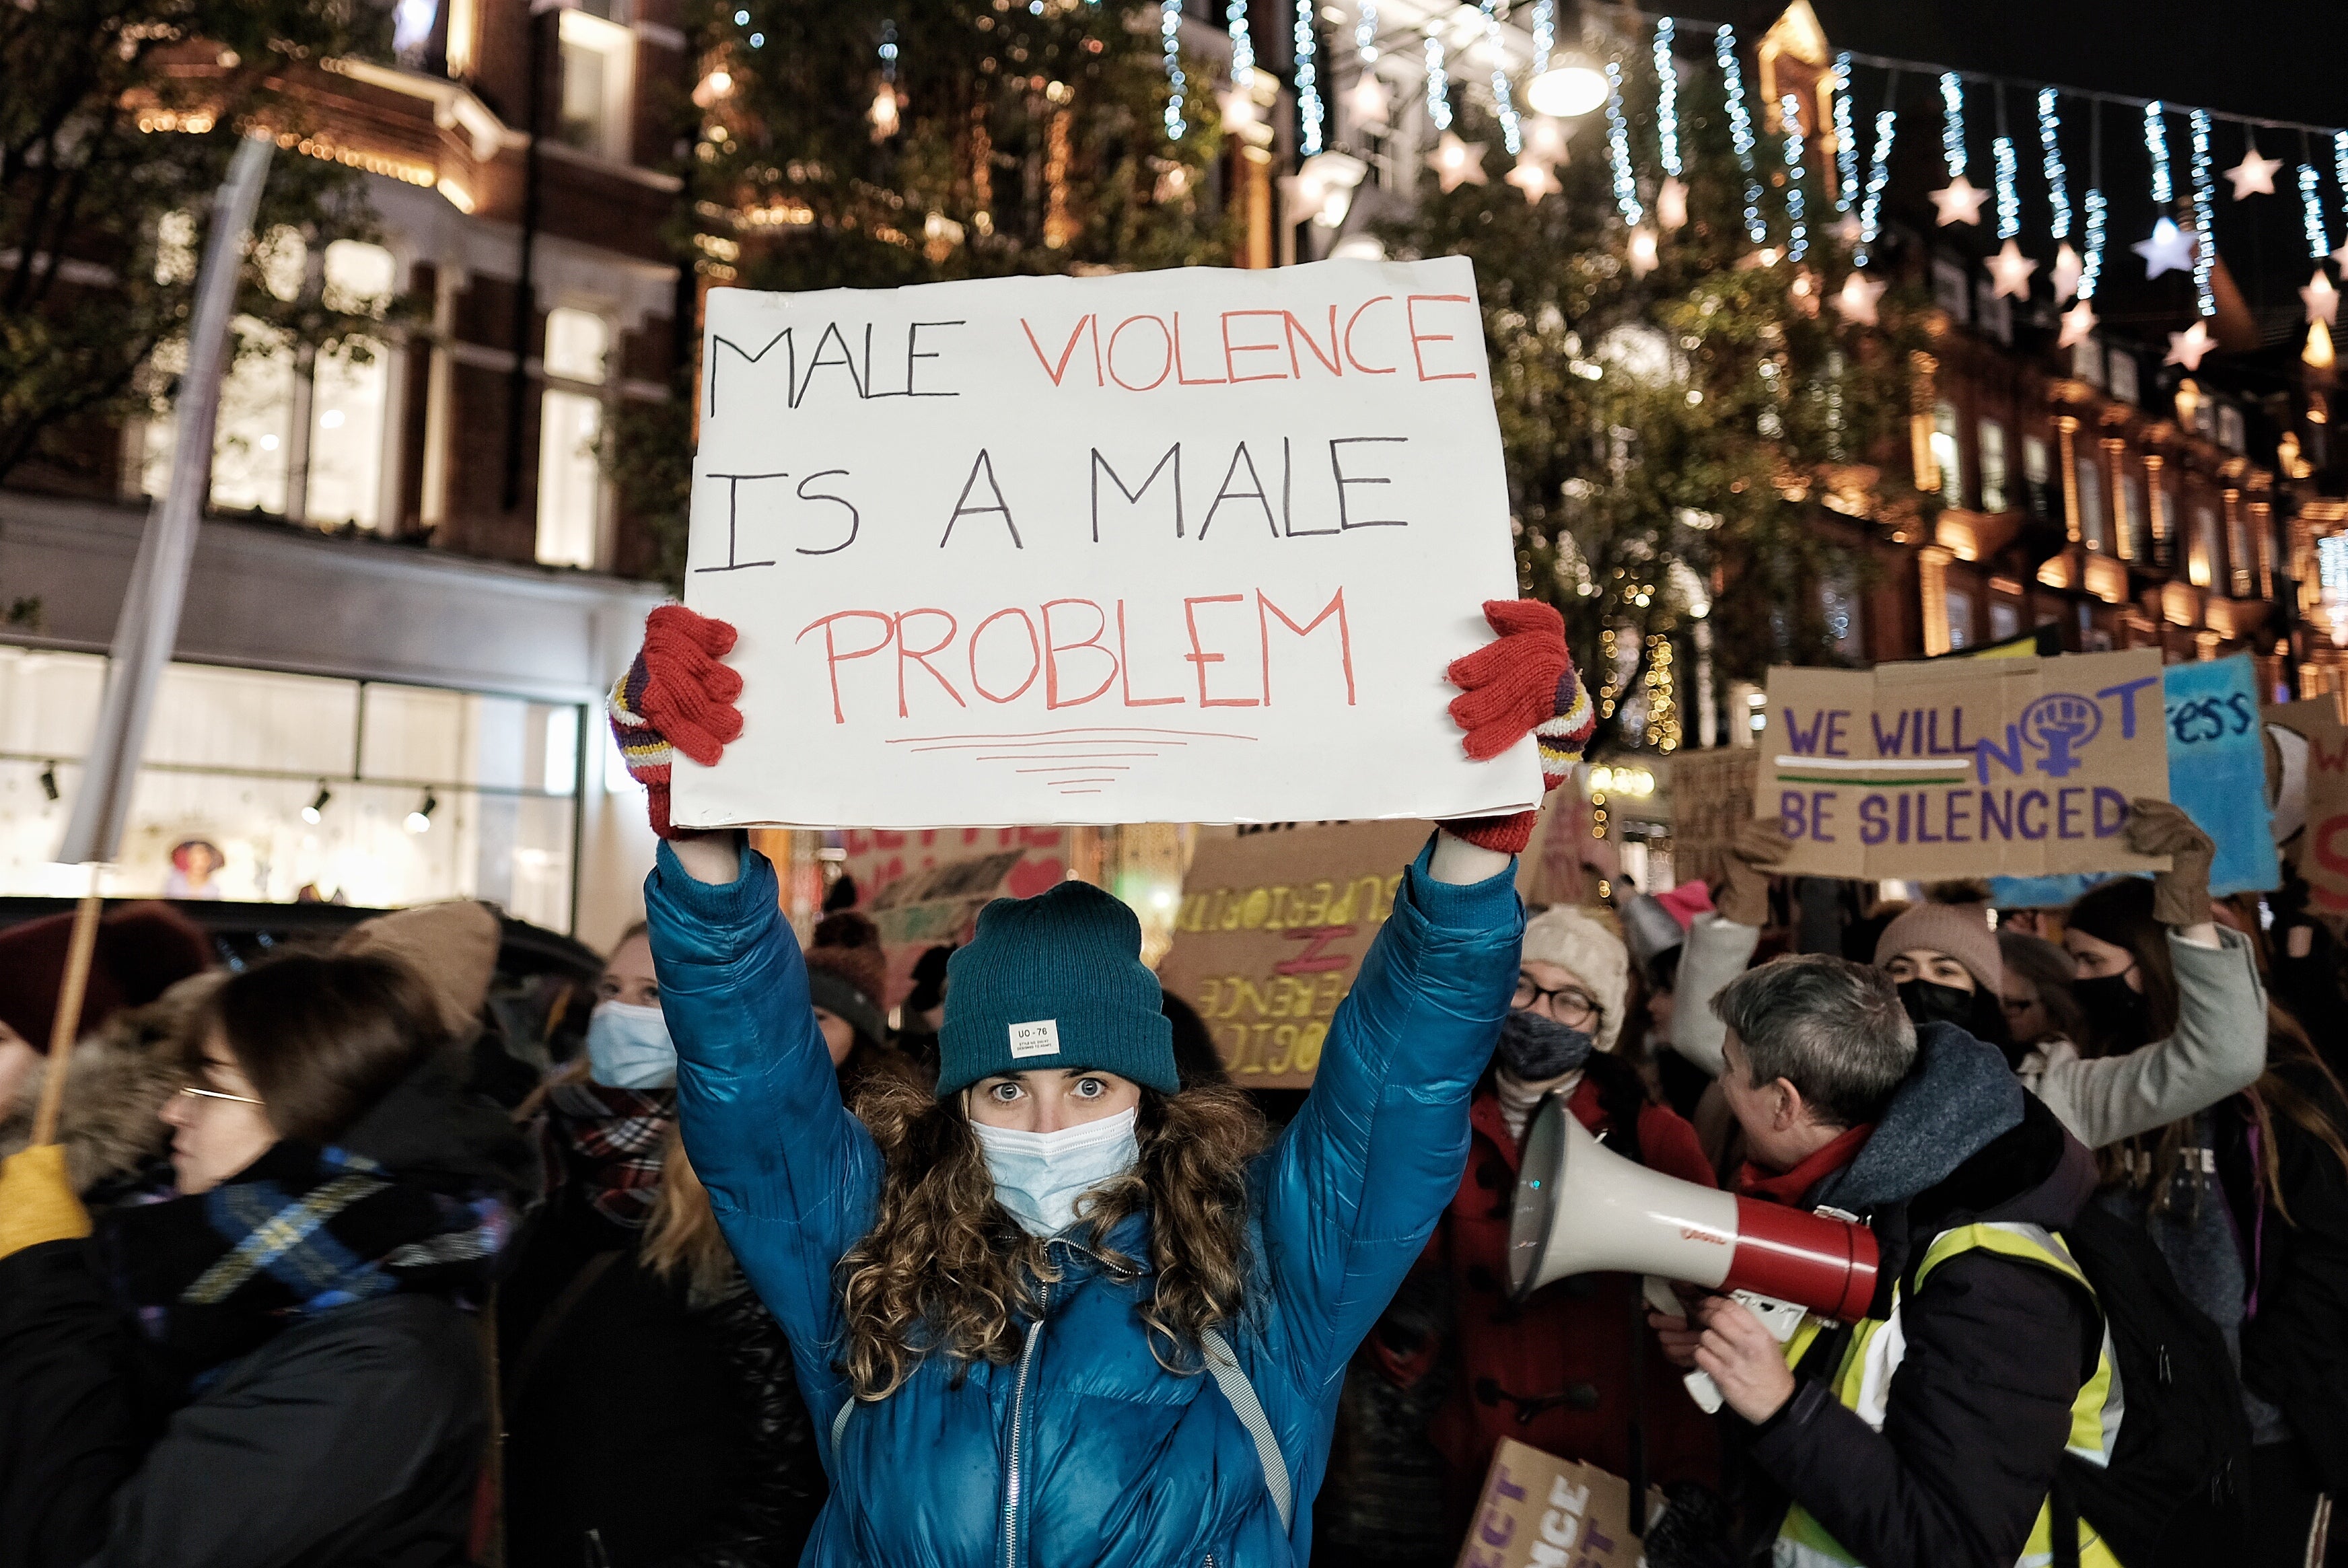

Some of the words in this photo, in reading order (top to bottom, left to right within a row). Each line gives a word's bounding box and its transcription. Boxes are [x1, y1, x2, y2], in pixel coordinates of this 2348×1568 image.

[709, 320, 966, 419] MALE
[1020, 294, 1477, 392] VIOLENCE
[695, 468, 859, 573] IS
[940, 448, 1024, 550] A
[1090, 436, 1409, 543] MALE
[795, 586, 1356, 725] PROBLEM
[1783, 707, 1851, 756] WE
[1871, 706, 1979, 756] WILL
[2166, 692, 2251, 744] ess
[1780, 790, 1837, 843] BE
[1858, 785, 2130, 846] SILENCED
[1018, 1029, 1030, 1038] UO
